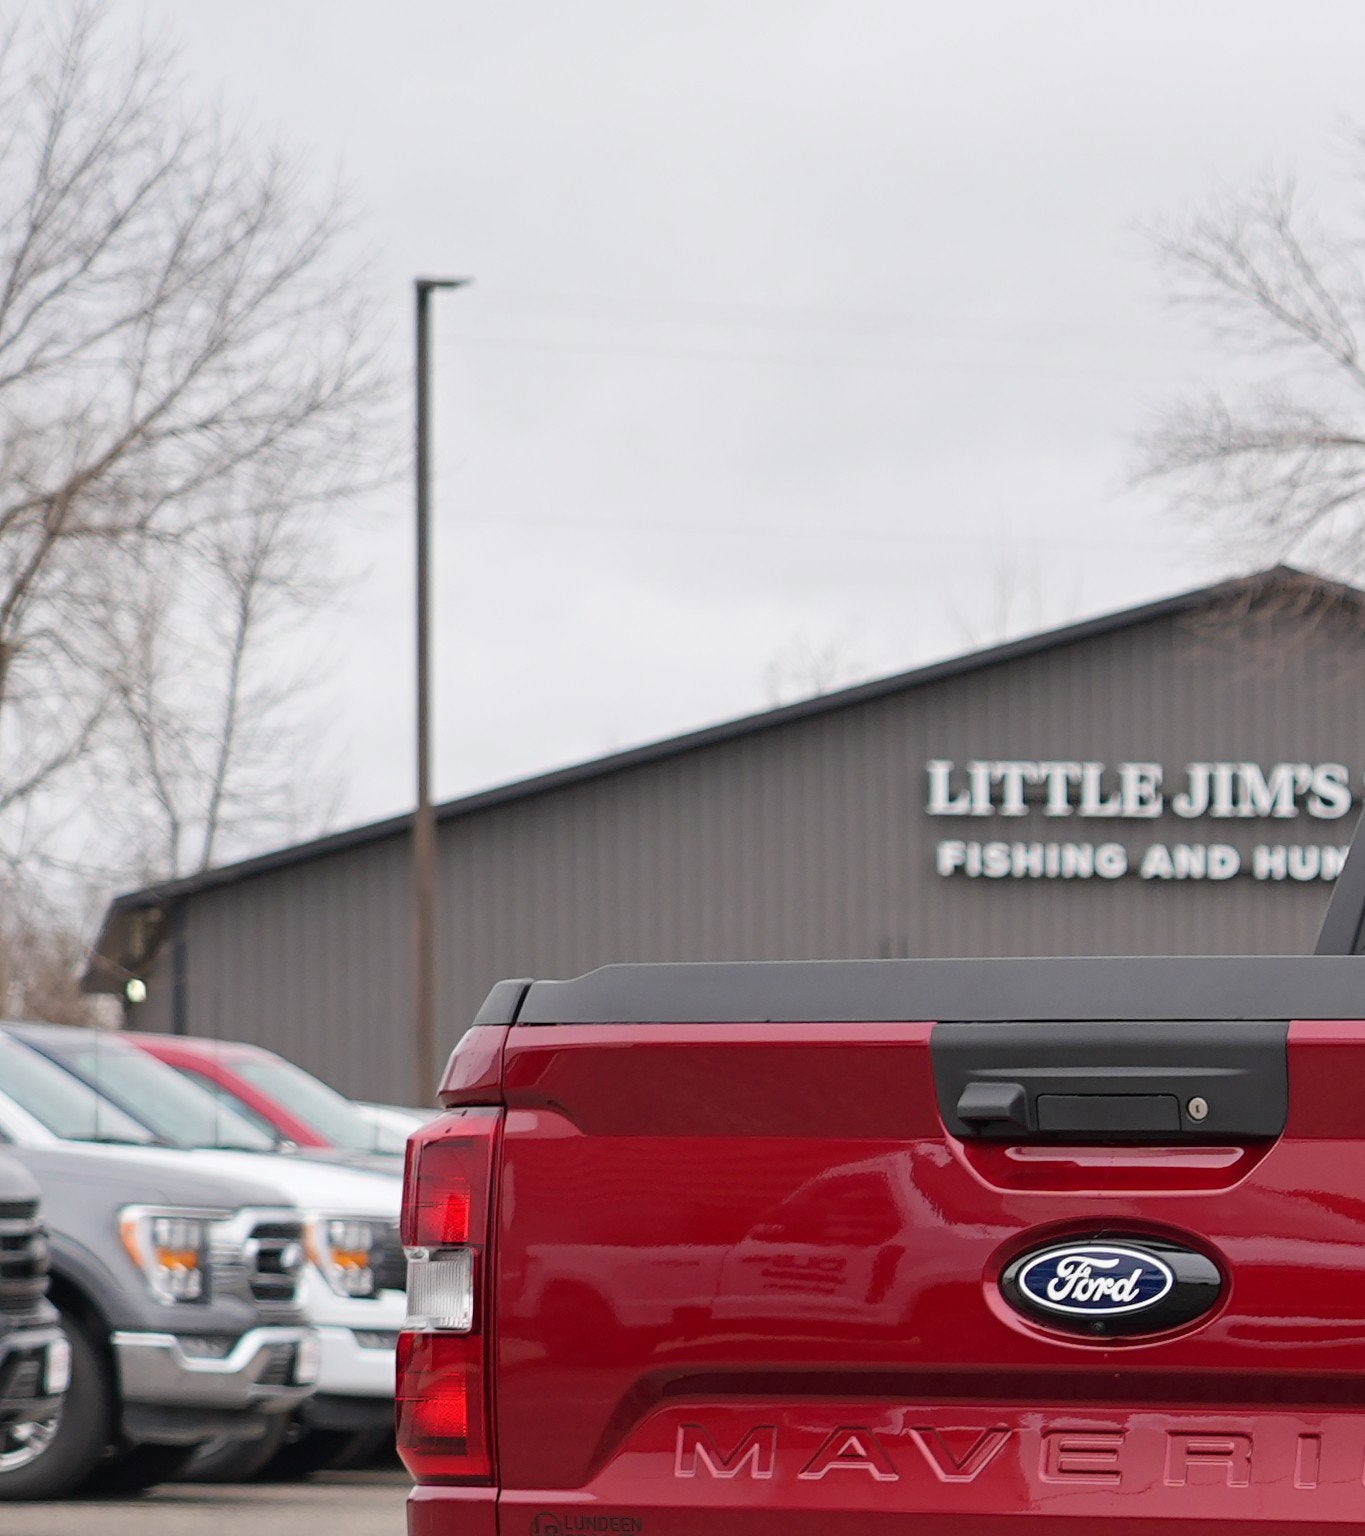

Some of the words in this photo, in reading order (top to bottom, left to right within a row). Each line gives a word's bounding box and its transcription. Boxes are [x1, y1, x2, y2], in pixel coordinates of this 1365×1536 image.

[925, 759, 1164, 818] LITTLE
[1172, 761, 1353, 820] JIM'S
[936, 840, 1128, 880] FISHING
[1140, 843, 1242, 881] AND
[1046, 1255, 1144, 1302] Ford
[564, 1515, 644, 1532] LUNDEEN
